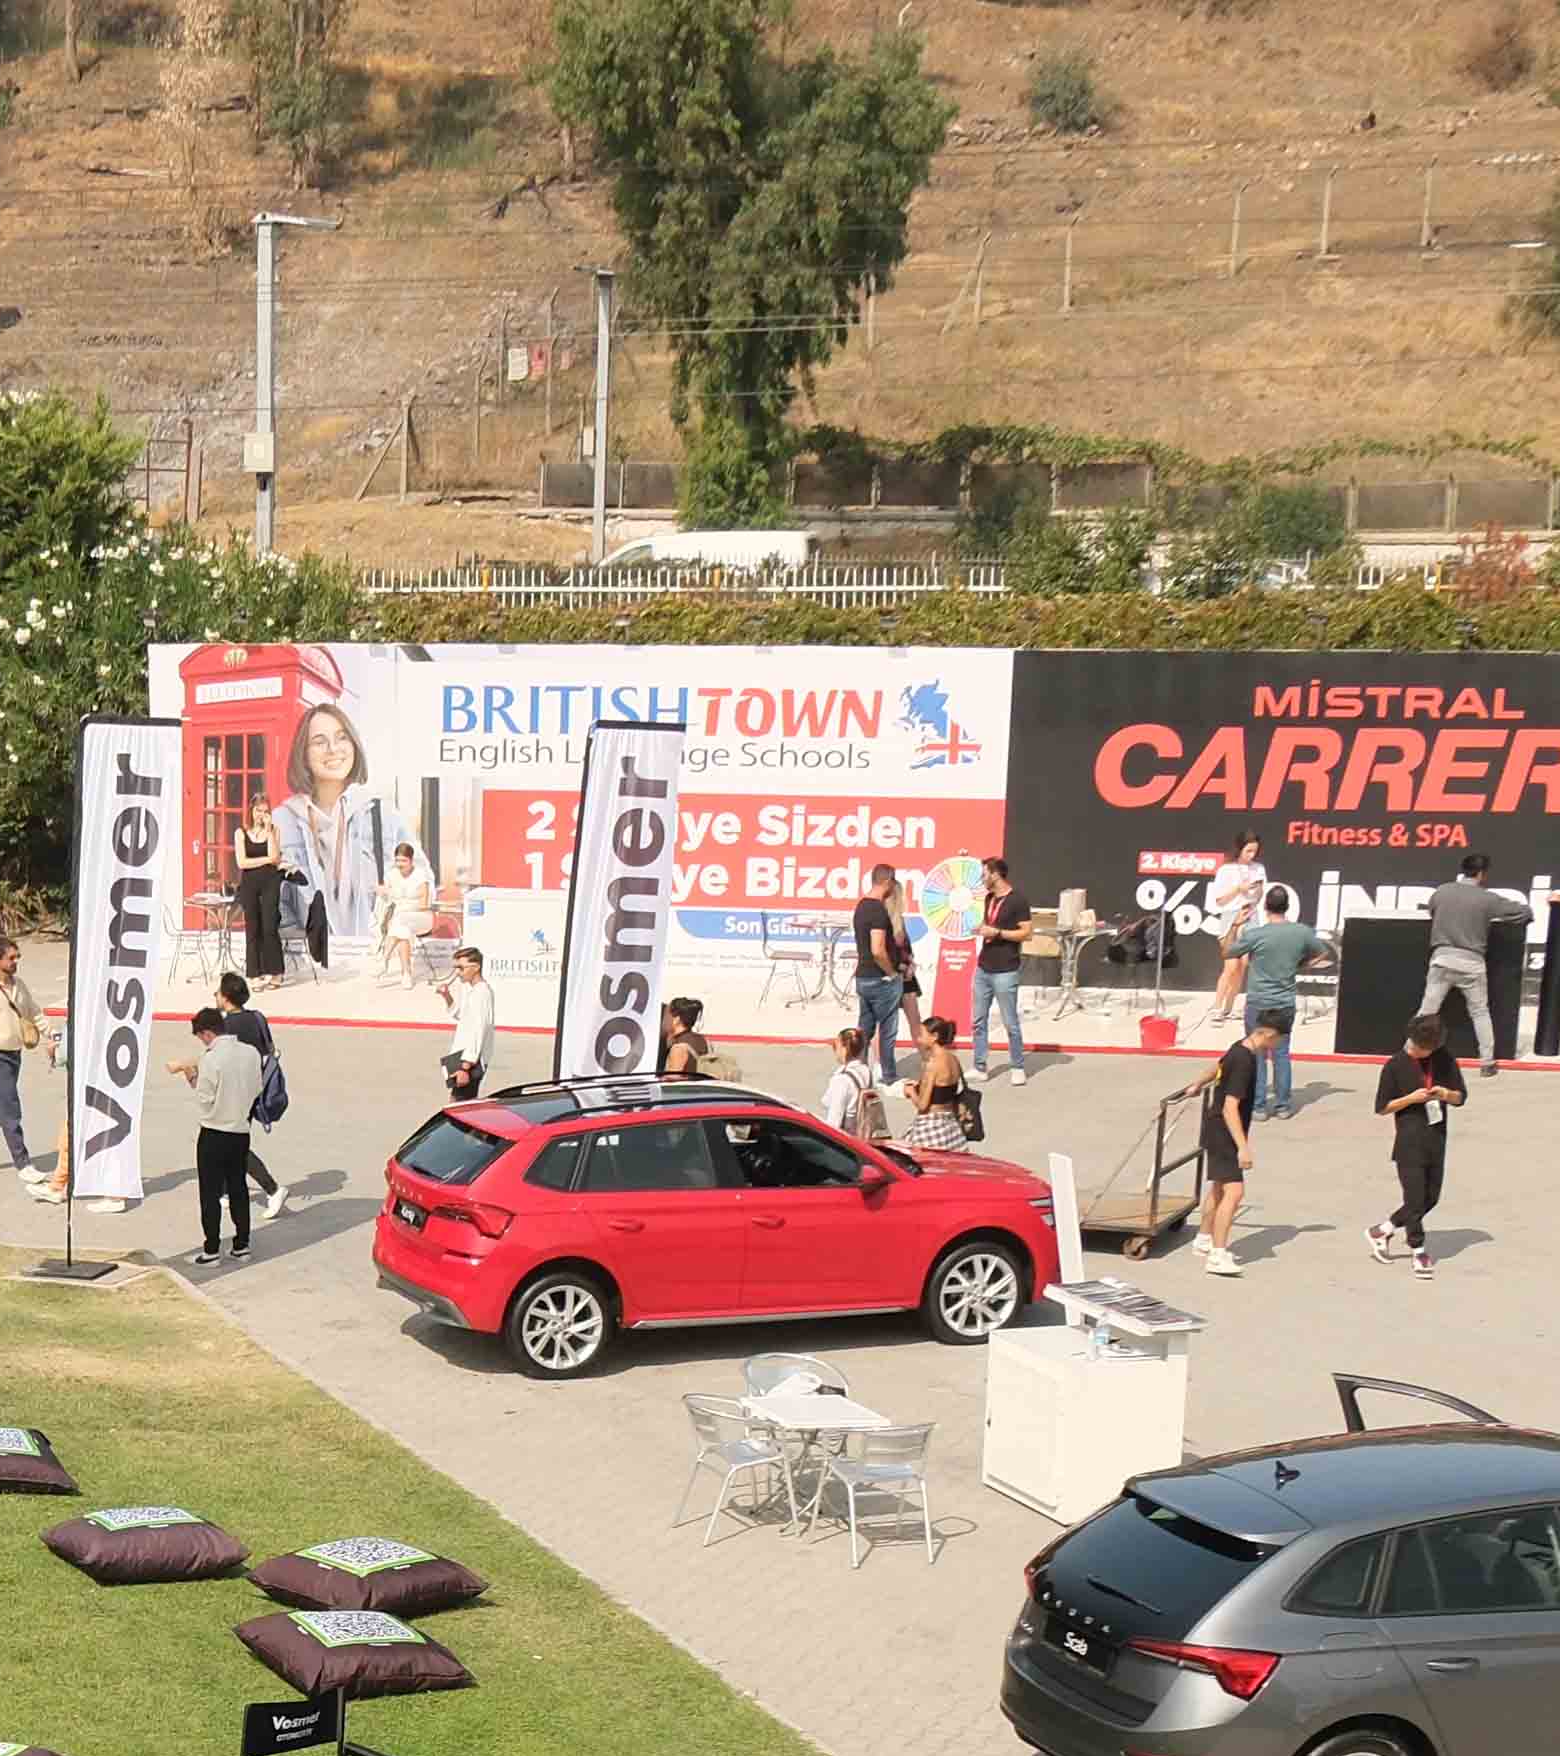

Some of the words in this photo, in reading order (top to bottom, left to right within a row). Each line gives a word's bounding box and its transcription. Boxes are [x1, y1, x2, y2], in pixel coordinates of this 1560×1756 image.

[1253, 680, 1526, 719] MİSTRAL
[439, 739, 556, 770] English
[740, 740, 871, 770] Schools
[525, 800, 557, 841] 2
[755, 804, 936, 849] Sizden
[1286, 820, 1382, 846] Fitness
[1387, 822, 1410, 848] &
[1415, 823, 1469, 849] SPA
[524, 851, 545, 897] 1
[744, 855, 928, 900] Bizdn
[594, 755, 669, 1076] osmer
[85, 752, 164, 1160] Vosmer
